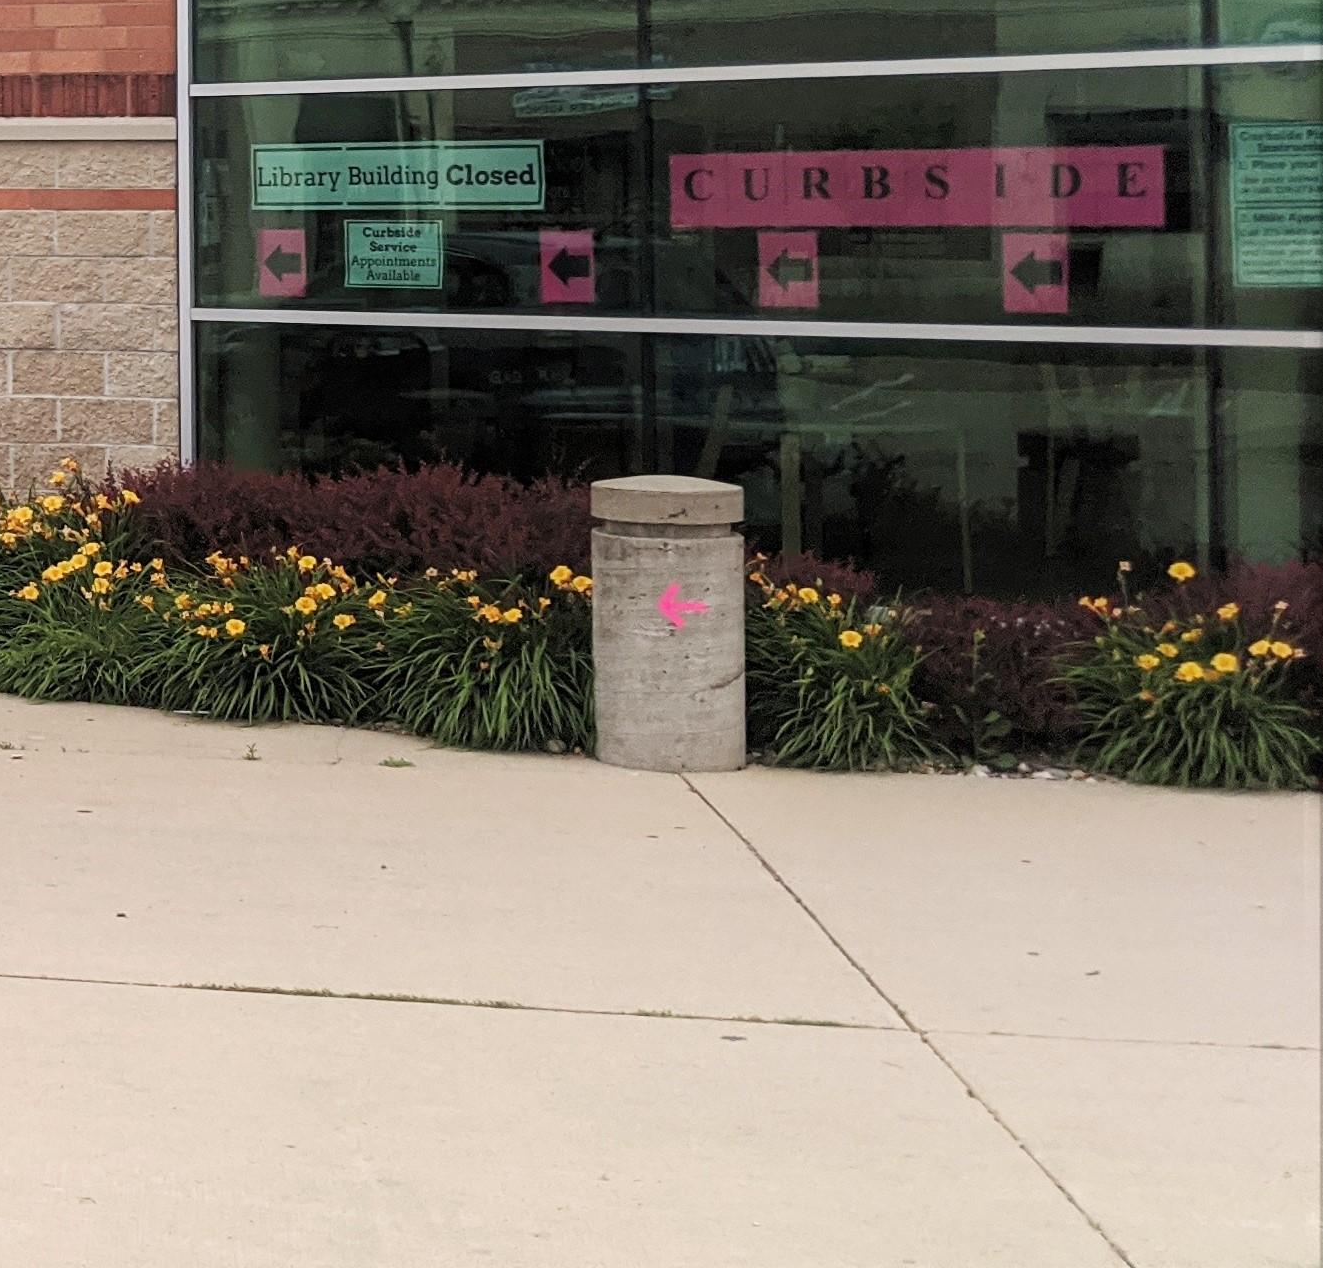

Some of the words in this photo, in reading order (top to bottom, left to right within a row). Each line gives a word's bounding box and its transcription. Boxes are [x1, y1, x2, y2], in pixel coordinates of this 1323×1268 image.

[256, 166, 341, 192] Library
[347, 165, 439, 190] Building
[445, 162, 537, 187] Closed
[683, 161, 1150, 202] CURBSIDE
[362, 227, 422, 239] Curbside
[369, 241, 418, 253] Service
[350, 255, 437, 269] Appointments
[366, 270, 421, 282] Available
